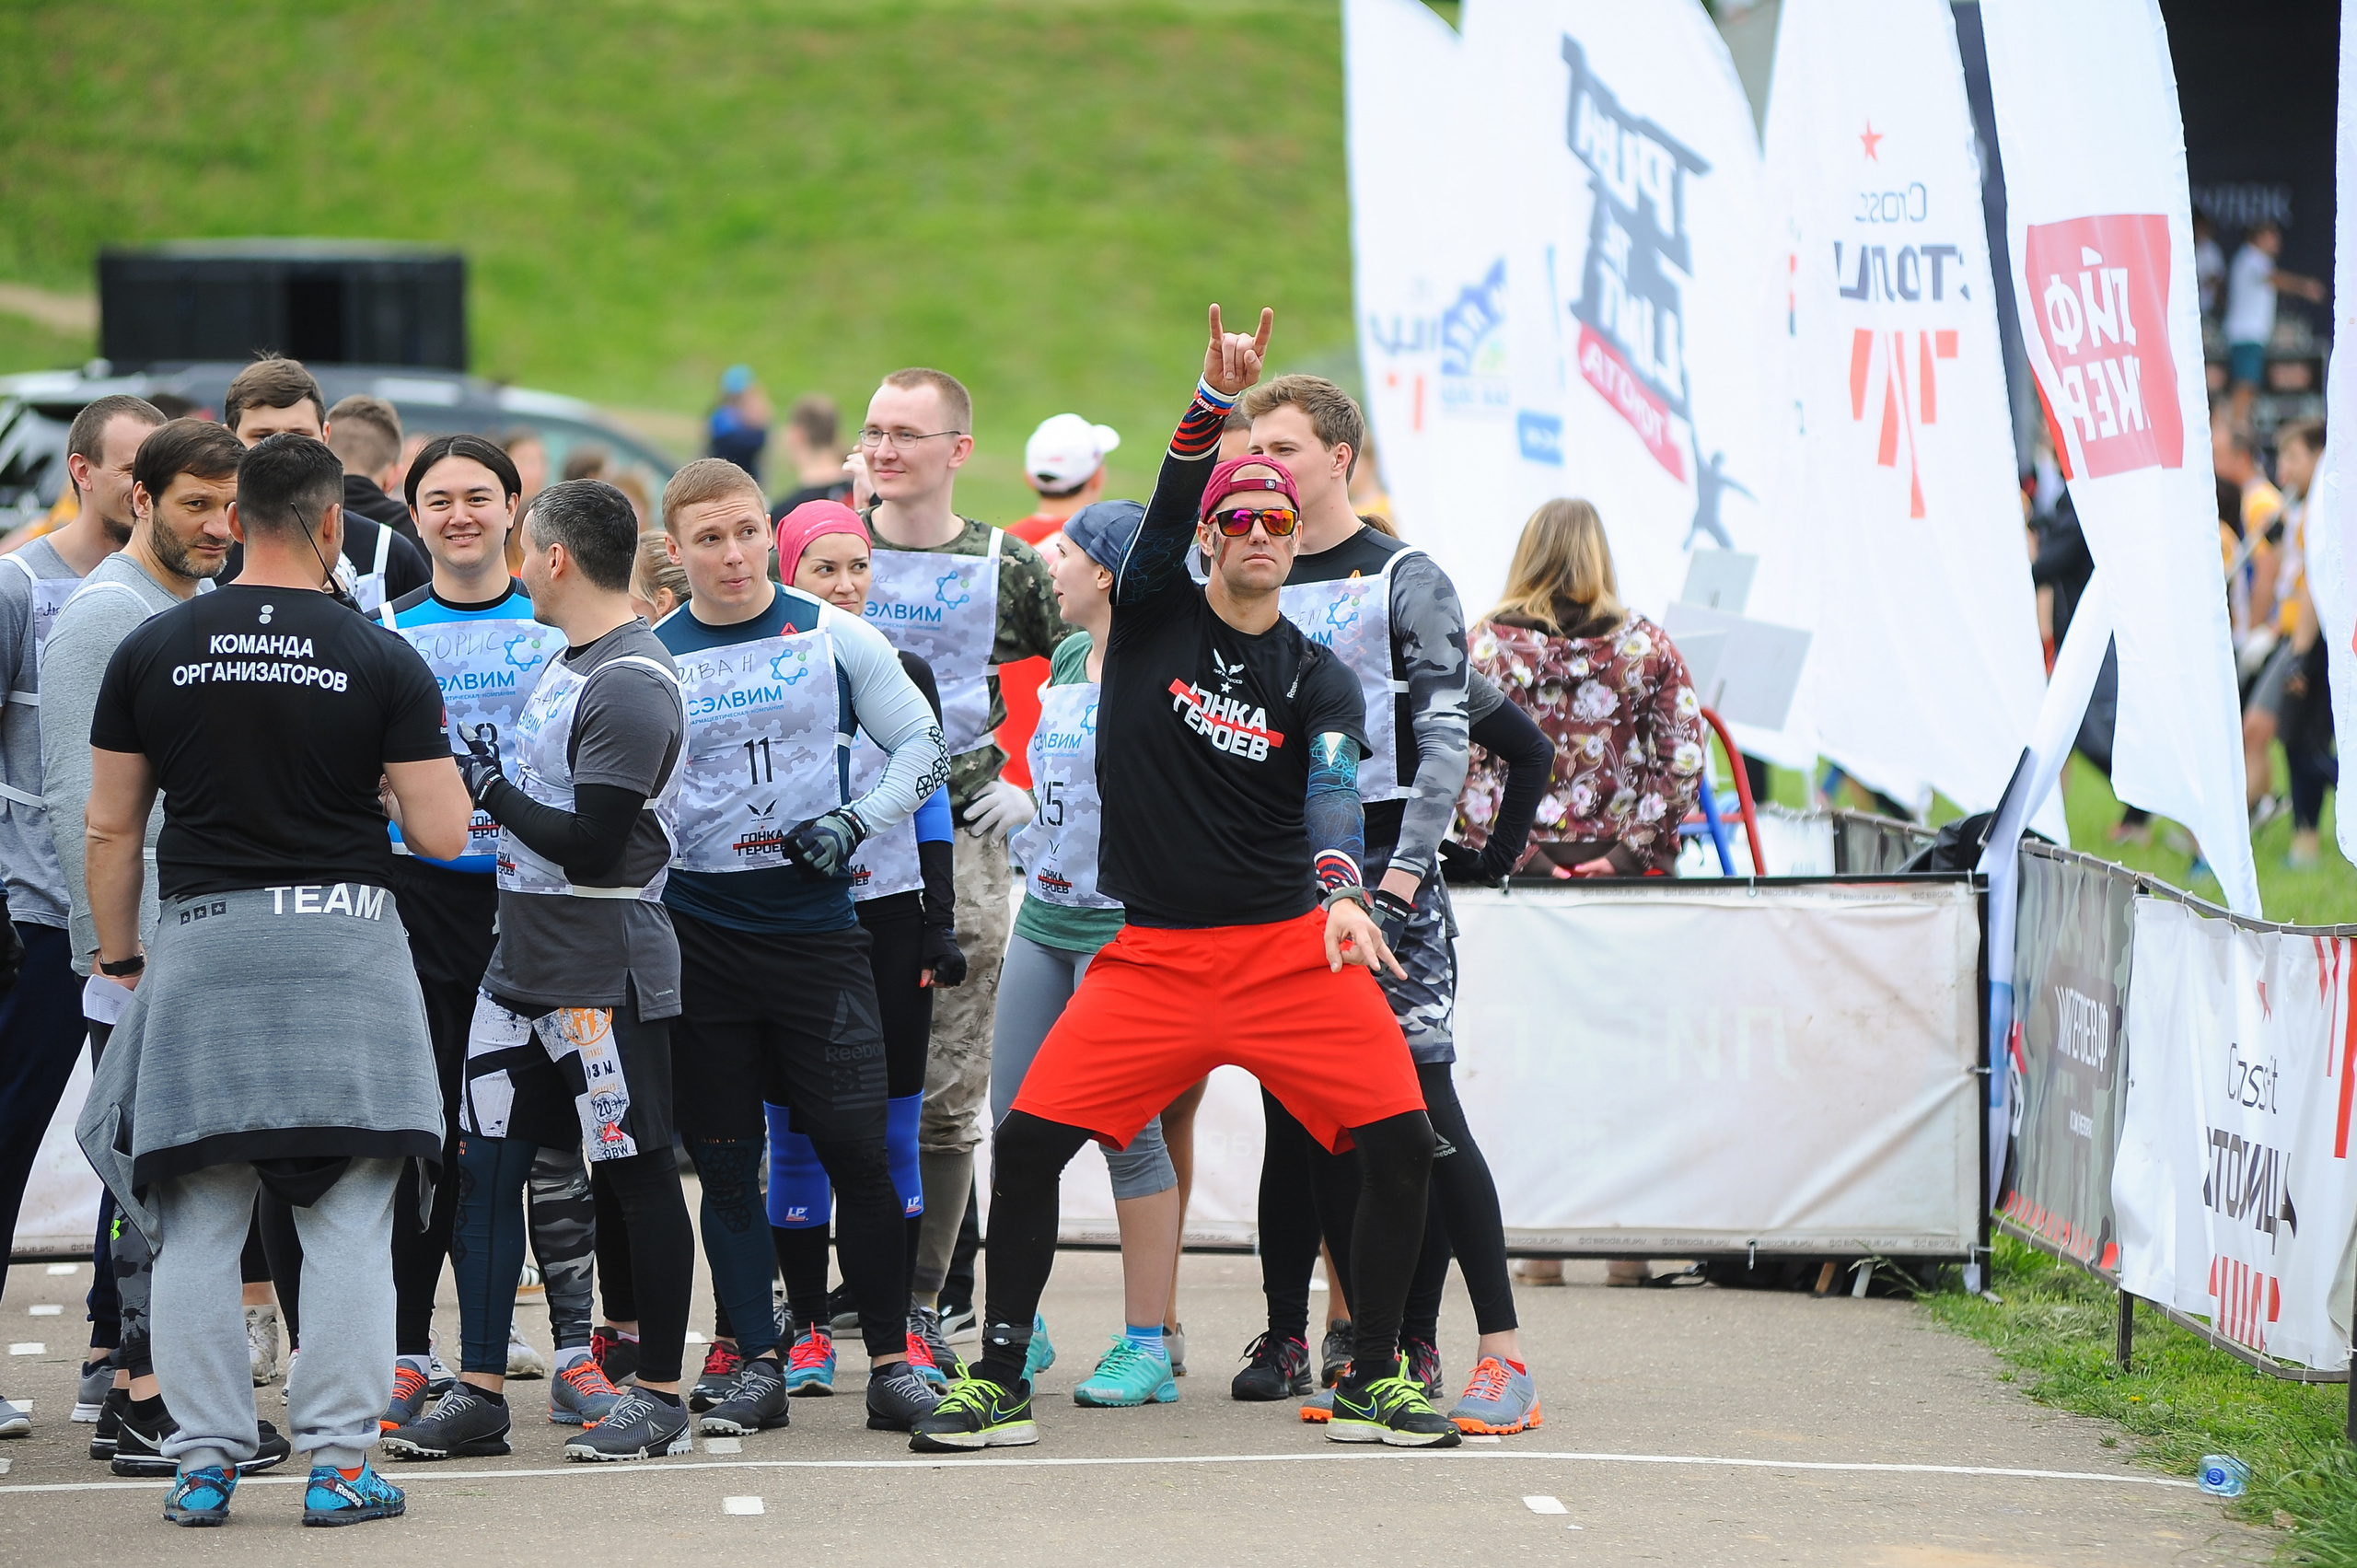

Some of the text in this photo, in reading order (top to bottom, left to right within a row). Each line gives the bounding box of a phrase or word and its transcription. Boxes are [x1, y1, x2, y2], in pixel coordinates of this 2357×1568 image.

[864, 601, 942, 622] ЭЛВИМ
[209, 633, 315, 659] КОМАНДА
[172, 661, 348, 692] ОРГАНИЗАТОРОВ
[434, 669, 516, 691] ЭЛВИМ
[690, 704, 784, 726] АРМАЦЕВТИЧЕСКАЯ КОМПАНИЯ
[1173, 691, 1270, 762] ГЕРОЕВ
[744, 736, 773, 785] 11
[740, 829, 784, 844] ГОНКА
[264, 882, 387, 921] TEAM
[334, 1483, 365, 1508] Reebok
